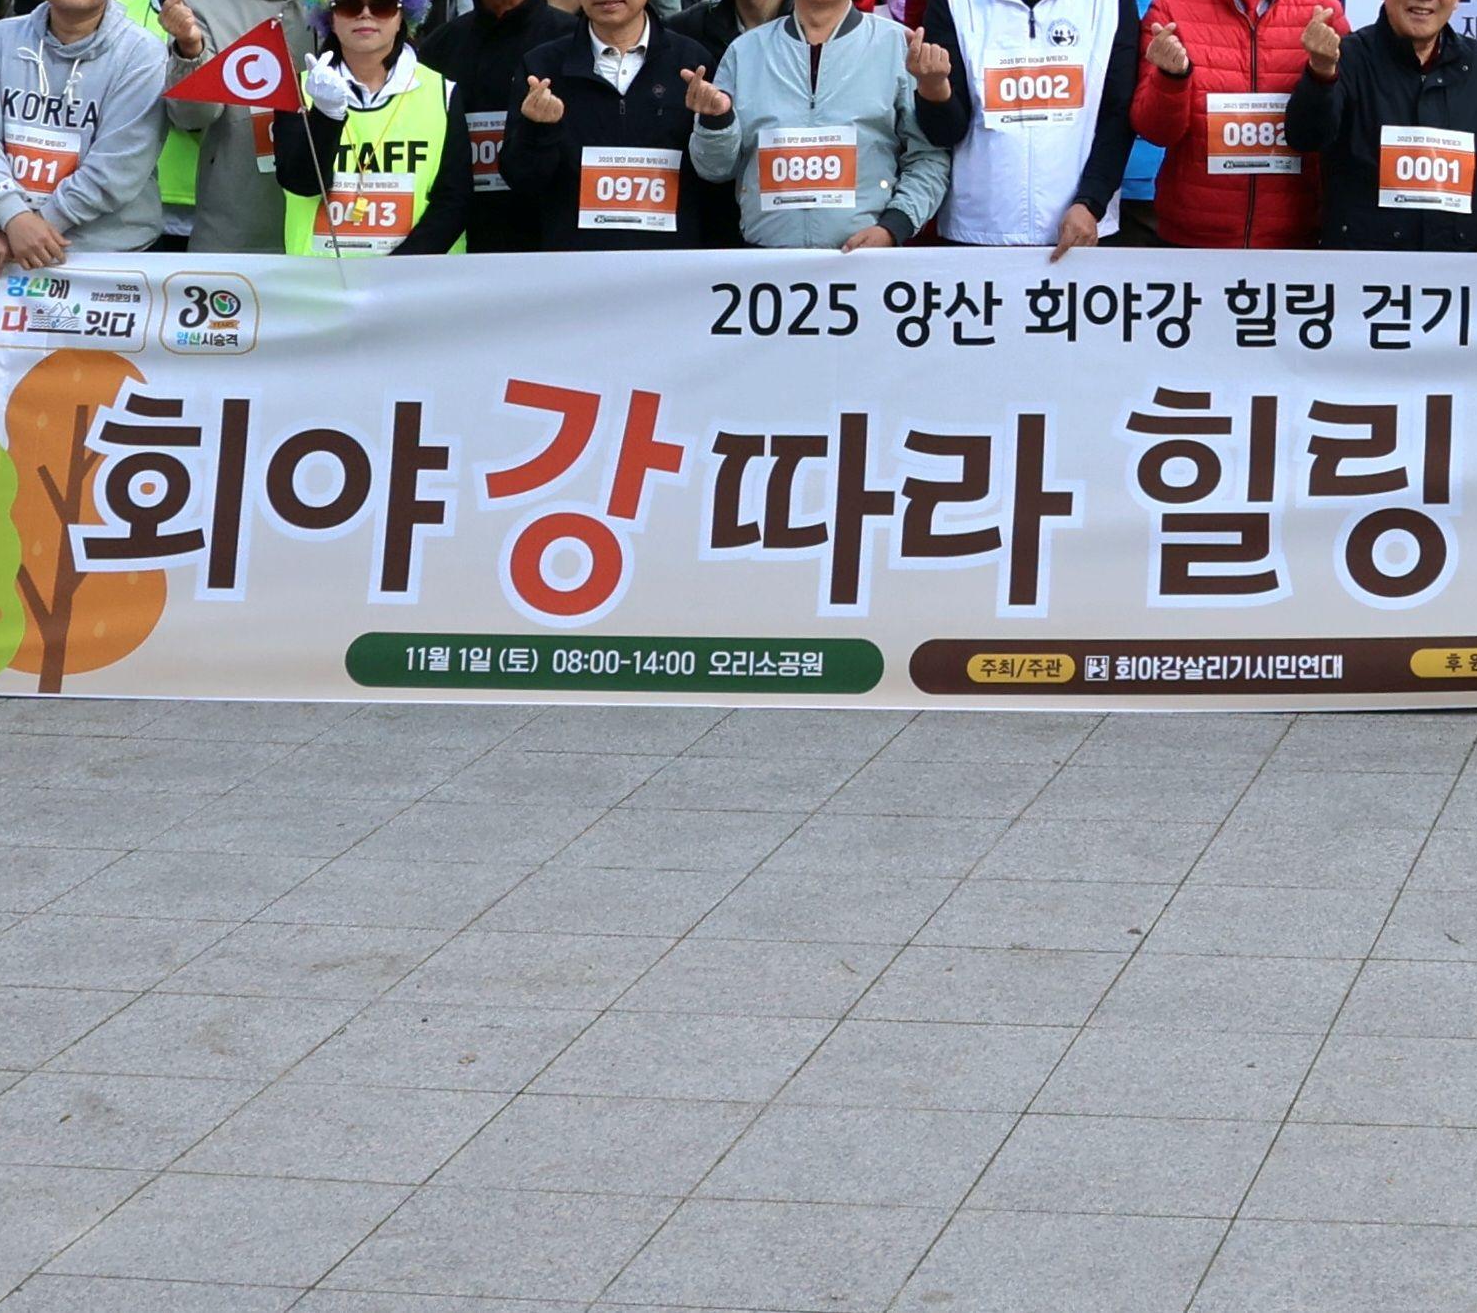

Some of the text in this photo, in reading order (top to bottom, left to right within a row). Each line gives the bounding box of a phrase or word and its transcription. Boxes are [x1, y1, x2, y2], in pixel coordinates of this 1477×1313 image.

[235, 53, 269, 91] C
[999, 74, 1070, 102] 0002
[3, 88, 99, 128] KOREA
[1223, 121, 1288, 147] 0882
[336, 141, 429, 174] TAFF
[771, 155, 841, 182] 0889
[1396, 155, 1460, 184] 0001
[595, 175, 667, 203] 0976
[6, 275, 71, 300] 양산에
[1, 304, 137, 338] 다 잇다
[710, 277, 1473, 351] 2025 양산 회야강 힐링 걷기
[176, 330, 239, 347] 양산시승격
[709, 411, 1074, 607] 따라
[1124, 387, 1456, 597] 힐링
[405, 646, 824, 678] 11월 1일 (토) 08:00-14:00 오리소공원
[979, 657, 1063, 678] 주최/주관
[1114, 654, 1344, 681] 회야강살리기시민연대
